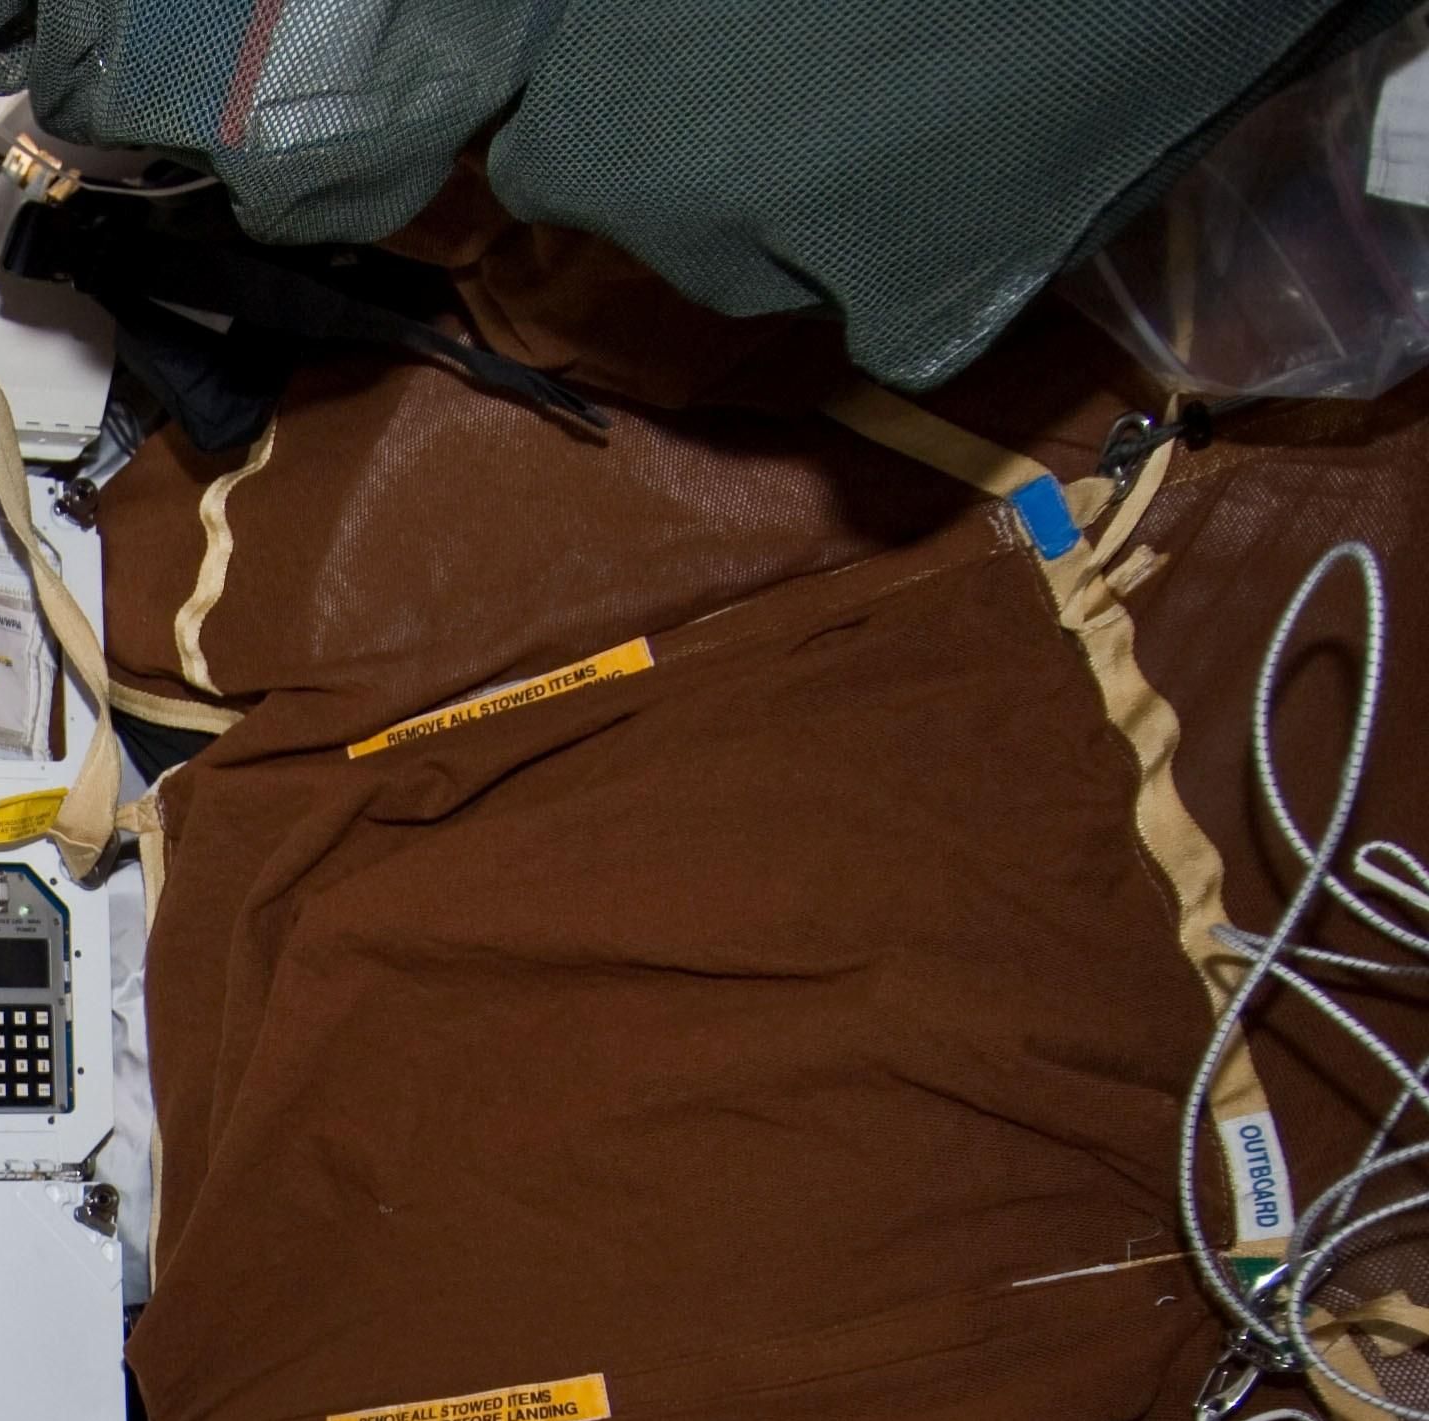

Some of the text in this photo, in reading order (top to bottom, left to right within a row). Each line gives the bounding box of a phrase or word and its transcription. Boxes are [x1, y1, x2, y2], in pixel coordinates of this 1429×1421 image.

[386, 716, 446, 747] REMOVE
[449, 709, 478, 728] ALL
[479, 683, 547, 717] STOWED
[548, 663, 598, 692] ITEMS
[1239, 1124, 1280, 1229] OUTBOARD
[411, 1407, 438, 1421] ALL
[440, 1397, 504, 1419] STOWED
[507, 1389, 553, 1408] ITEMS
